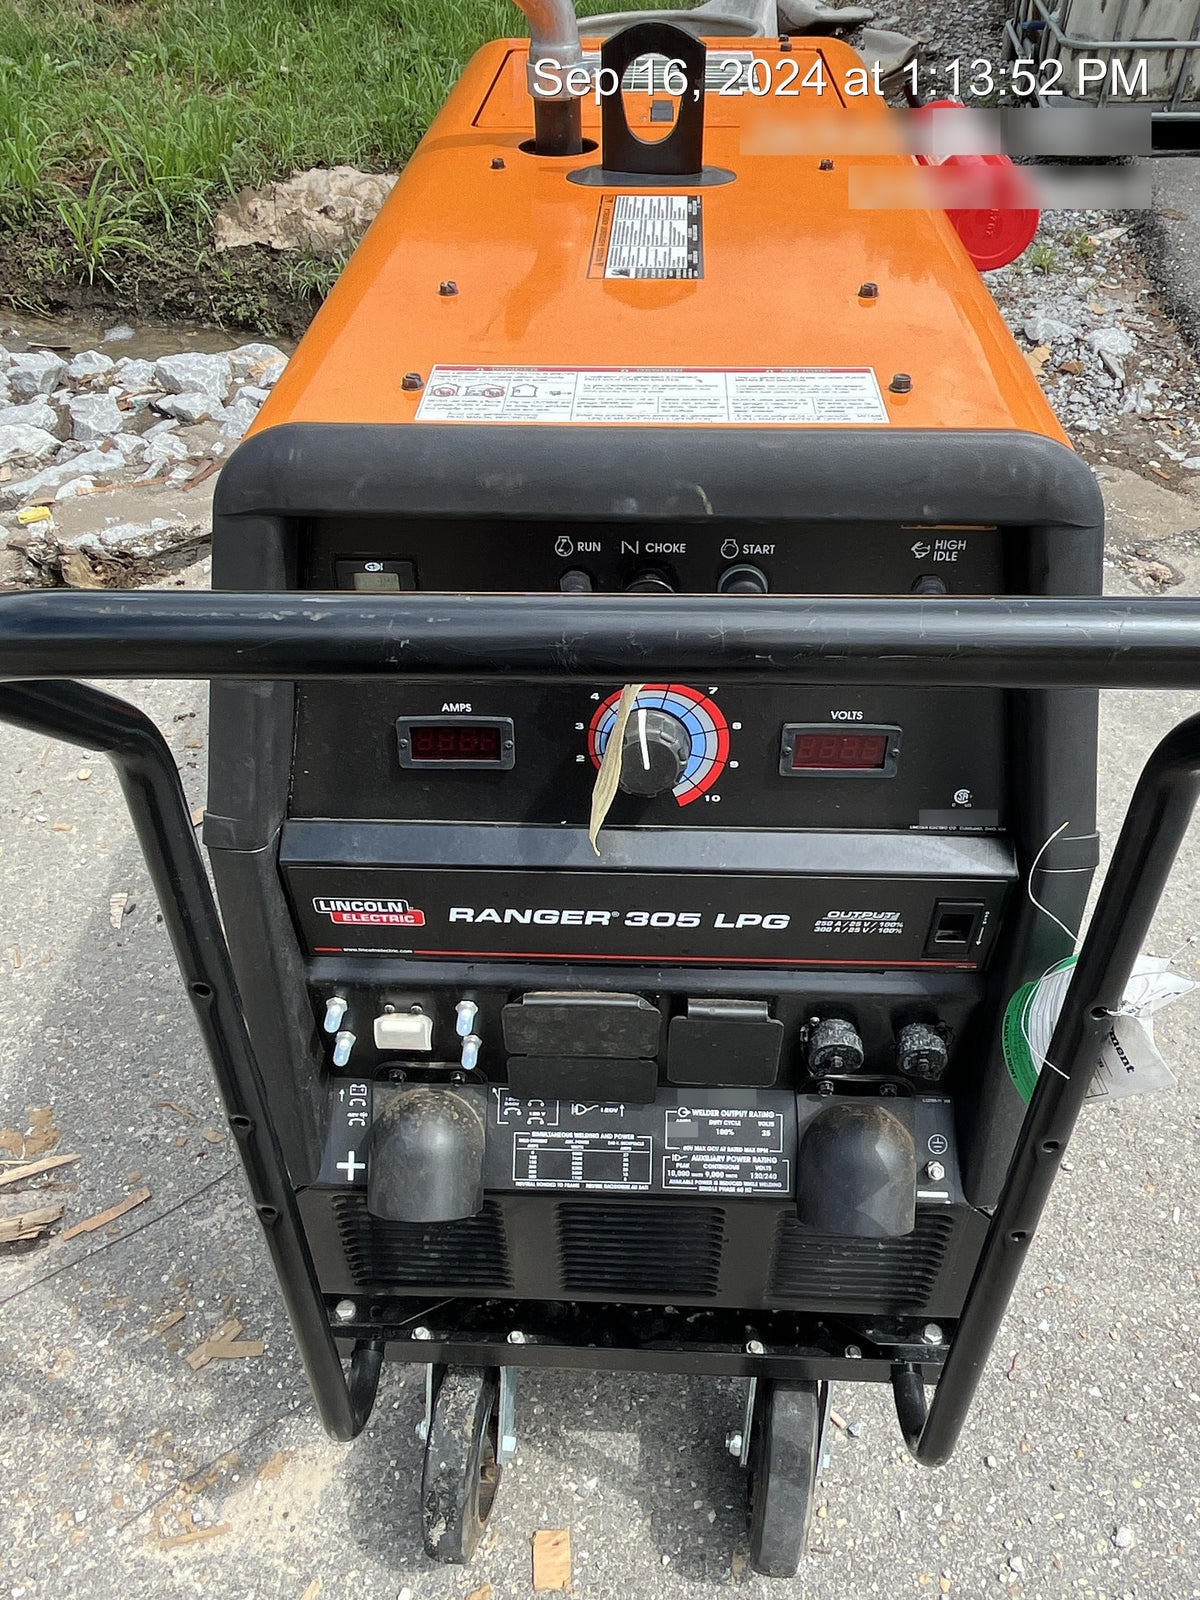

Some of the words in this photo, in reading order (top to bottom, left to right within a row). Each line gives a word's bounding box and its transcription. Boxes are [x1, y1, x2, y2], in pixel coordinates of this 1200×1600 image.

[577, 541, 601, 552] RUN
[645, 542, 687, 554] CHOKE
[742, 544, 776, 555] START
[935, 539, 967, 551] HIGH
[933, 550, 958, 562] IDLE
[707, 686, 719, 695] 7
[590, 692, 600, 701] 4
[441, 702, 472, 713] AMPS
[830, 710, 864, 721] VOLTS
[574, 722, 585, 731] 3
[575, 754, 586, 762] 2
[704, 794, 721, 802] 10
[318, 899, 404, 913] LINCOLN
[341, 913, 415, 924] ELECTRIC
[827, 910, 896, 919] OUTPUT
[624, 911, 702, 927] 305
[713, 913, 792, 930] LPG
[1003, 1014, 1012, 1043] READY
[1006, 1057, 1018, 1080] RENT
[692, 1108, 719, 1117] WELDER
[720, 1109, 748, 1118] OUTPUT
[748, 1110, 775, 1119] RATING
[691, 1154, 725, 1163] AUXILIARY
[725, 1155, 751, 1163] POWER
[752, 1156, 778, 1164] RATING
[667, 1169, 691, 1178] 10,000
